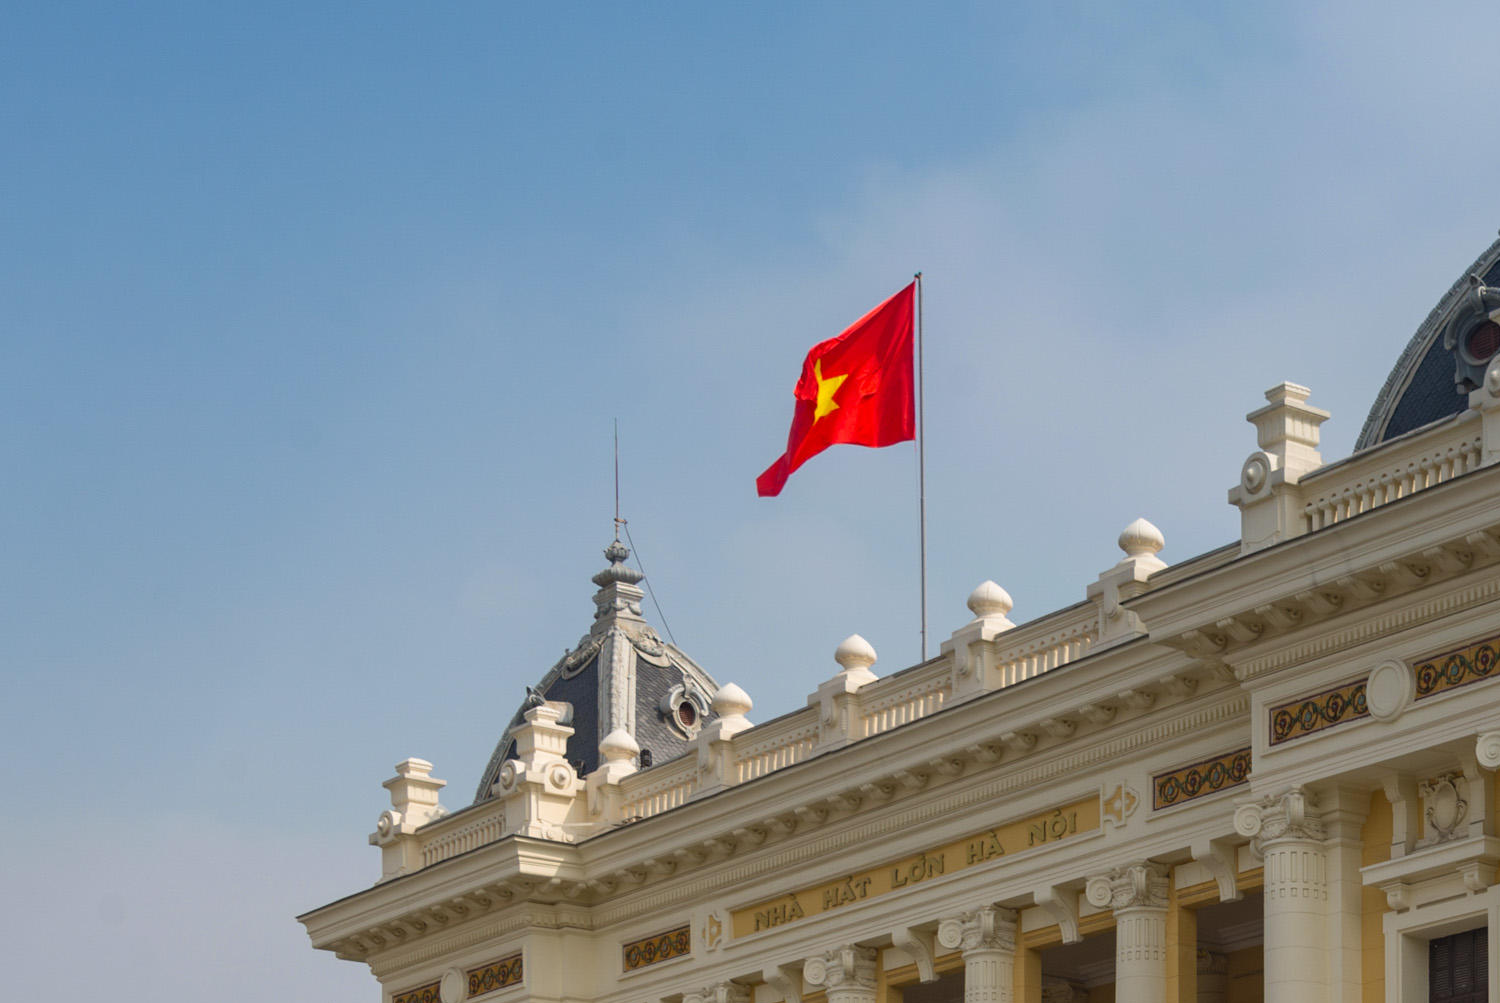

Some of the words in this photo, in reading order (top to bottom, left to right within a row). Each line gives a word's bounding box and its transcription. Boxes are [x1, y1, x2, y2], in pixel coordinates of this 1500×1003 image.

[754, 893, 805, 931] NHÀ
[822, 876, 872, 911] HÁT
[891, 853, 945, 889] LỚN
[967, 829, 1005, 865] HÀ
[1028, 809, 1077, 846] NỘI
